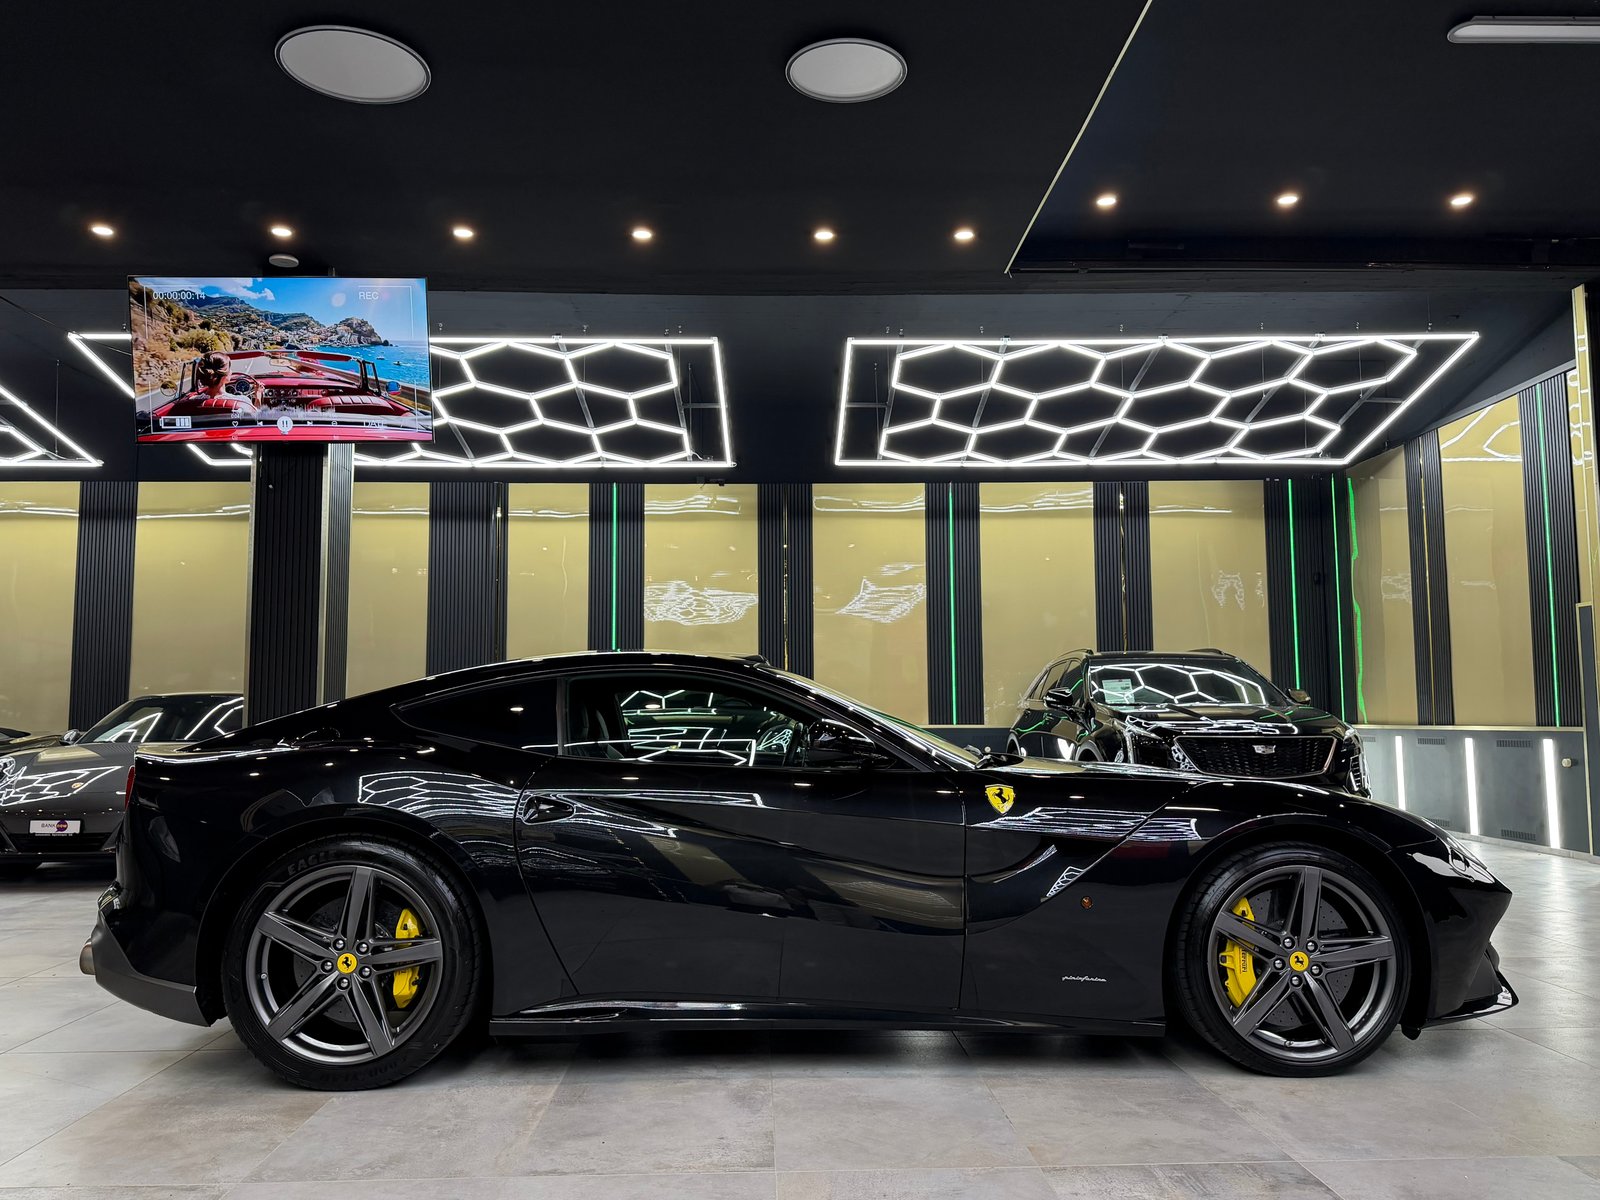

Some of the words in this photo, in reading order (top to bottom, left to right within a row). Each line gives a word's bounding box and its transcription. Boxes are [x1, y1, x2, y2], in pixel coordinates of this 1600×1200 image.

[152, 291, 206, 300] 00:00:00:14
[358, 291, 379, 300] REC
[287, 850, 337, 876] EAGLE
